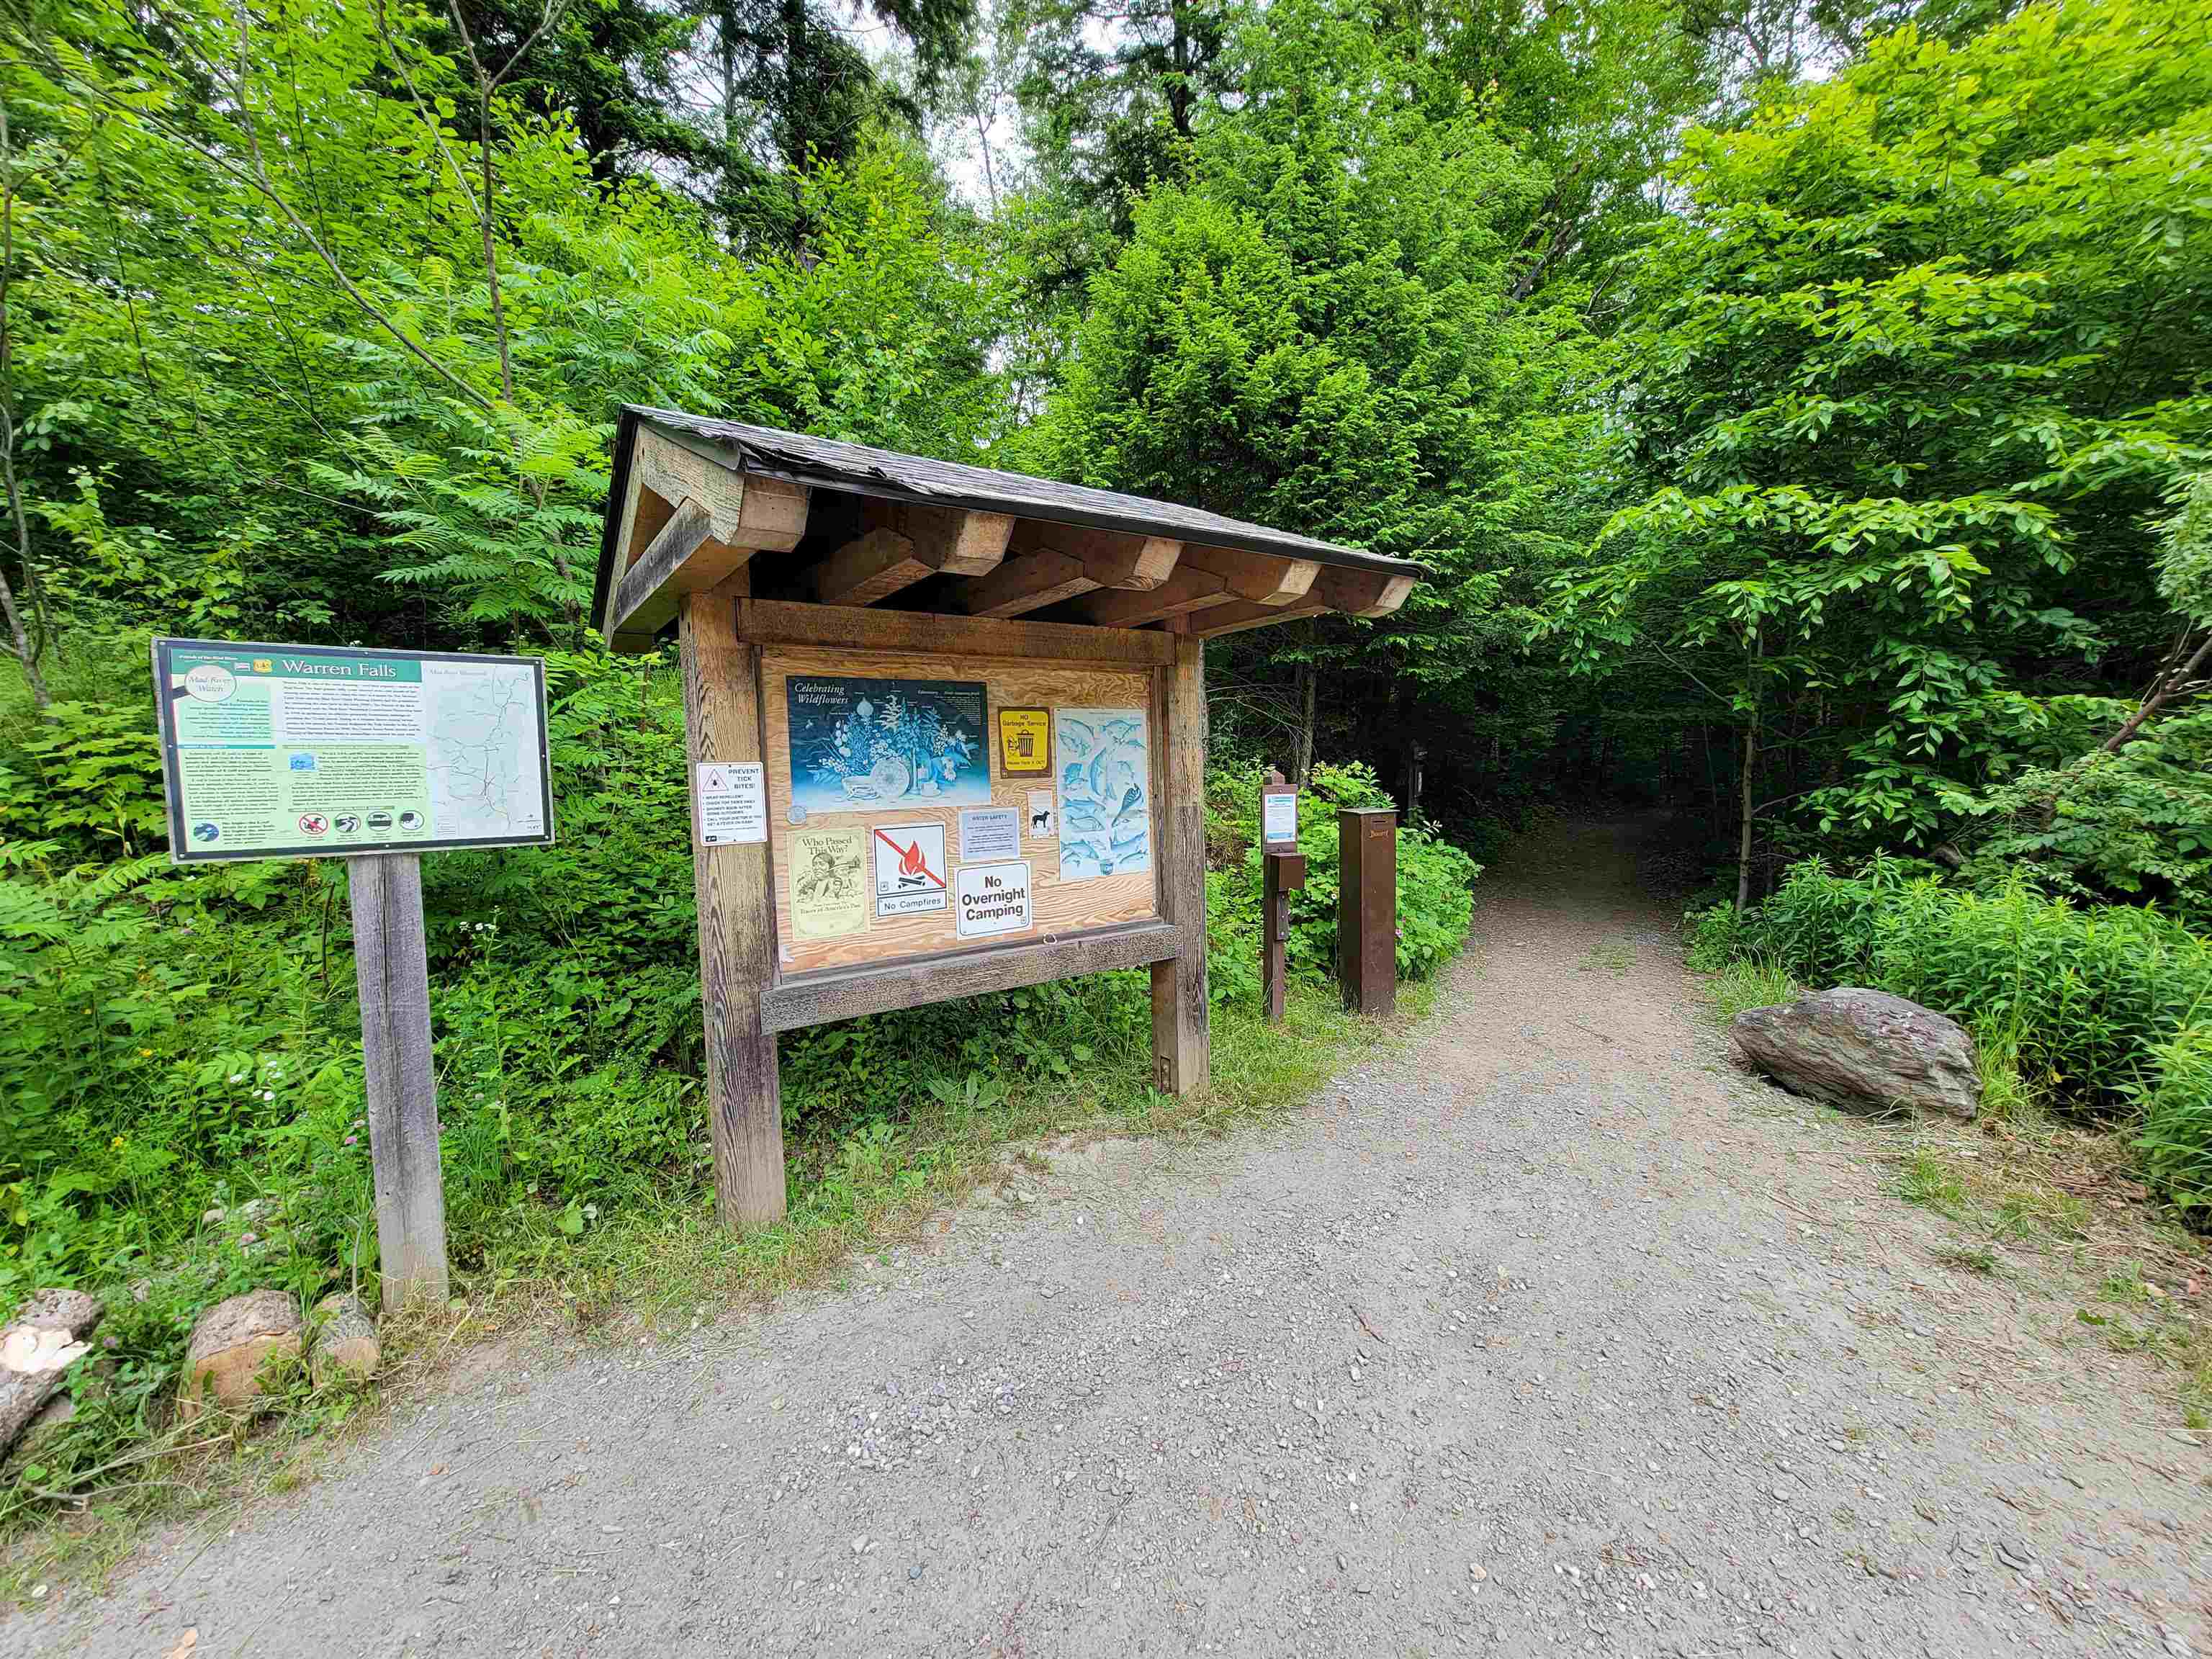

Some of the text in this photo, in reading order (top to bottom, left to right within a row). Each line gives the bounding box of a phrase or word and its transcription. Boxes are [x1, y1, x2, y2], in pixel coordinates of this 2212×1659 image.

[282, 659, 352, 675] Warren
[359, 662, 397, 678] Falls
[794, 683, 845, 696] Celebrating
[797, 693, 850, 707] Wildflowers
[802, 835, 853, 847] Who Passed
[807, 844, 848, 855] This Way?
[984, 876, 1002, 889] No
[961, 887, 1026, 906] Overnight
[884, 898, 941, 911] No Campfires
[966, 904, 1023, 921] Camping
